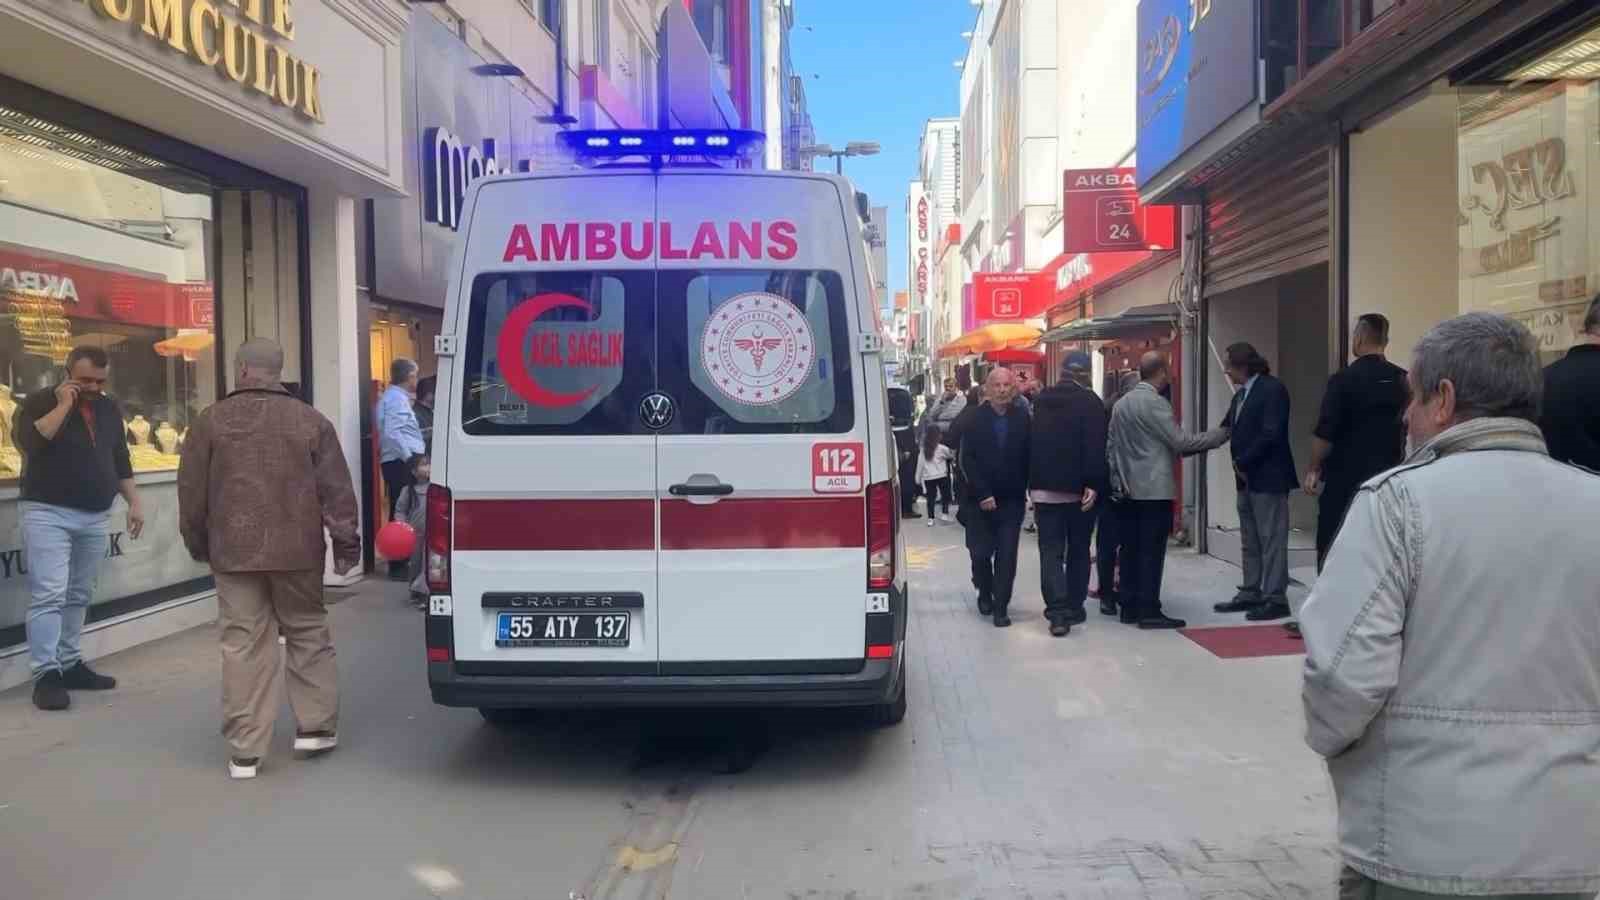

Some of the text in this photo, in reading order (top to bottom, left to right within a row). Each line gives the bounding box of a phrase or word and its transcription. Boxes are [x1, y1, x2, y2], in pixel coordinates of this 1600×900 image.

[917, 196, 929, 242] AKSU
[503, 221, 798, 262] AMBULANS
[1109, 223, 1131, 240] 24
[820, 448, 856, 473] 112
[511, 596, 613, 607] CRAFTER
[510, 616, 533, 638] 55
[544, 616, 579, 638] ATY
[594, 616, 626, 638] 137
